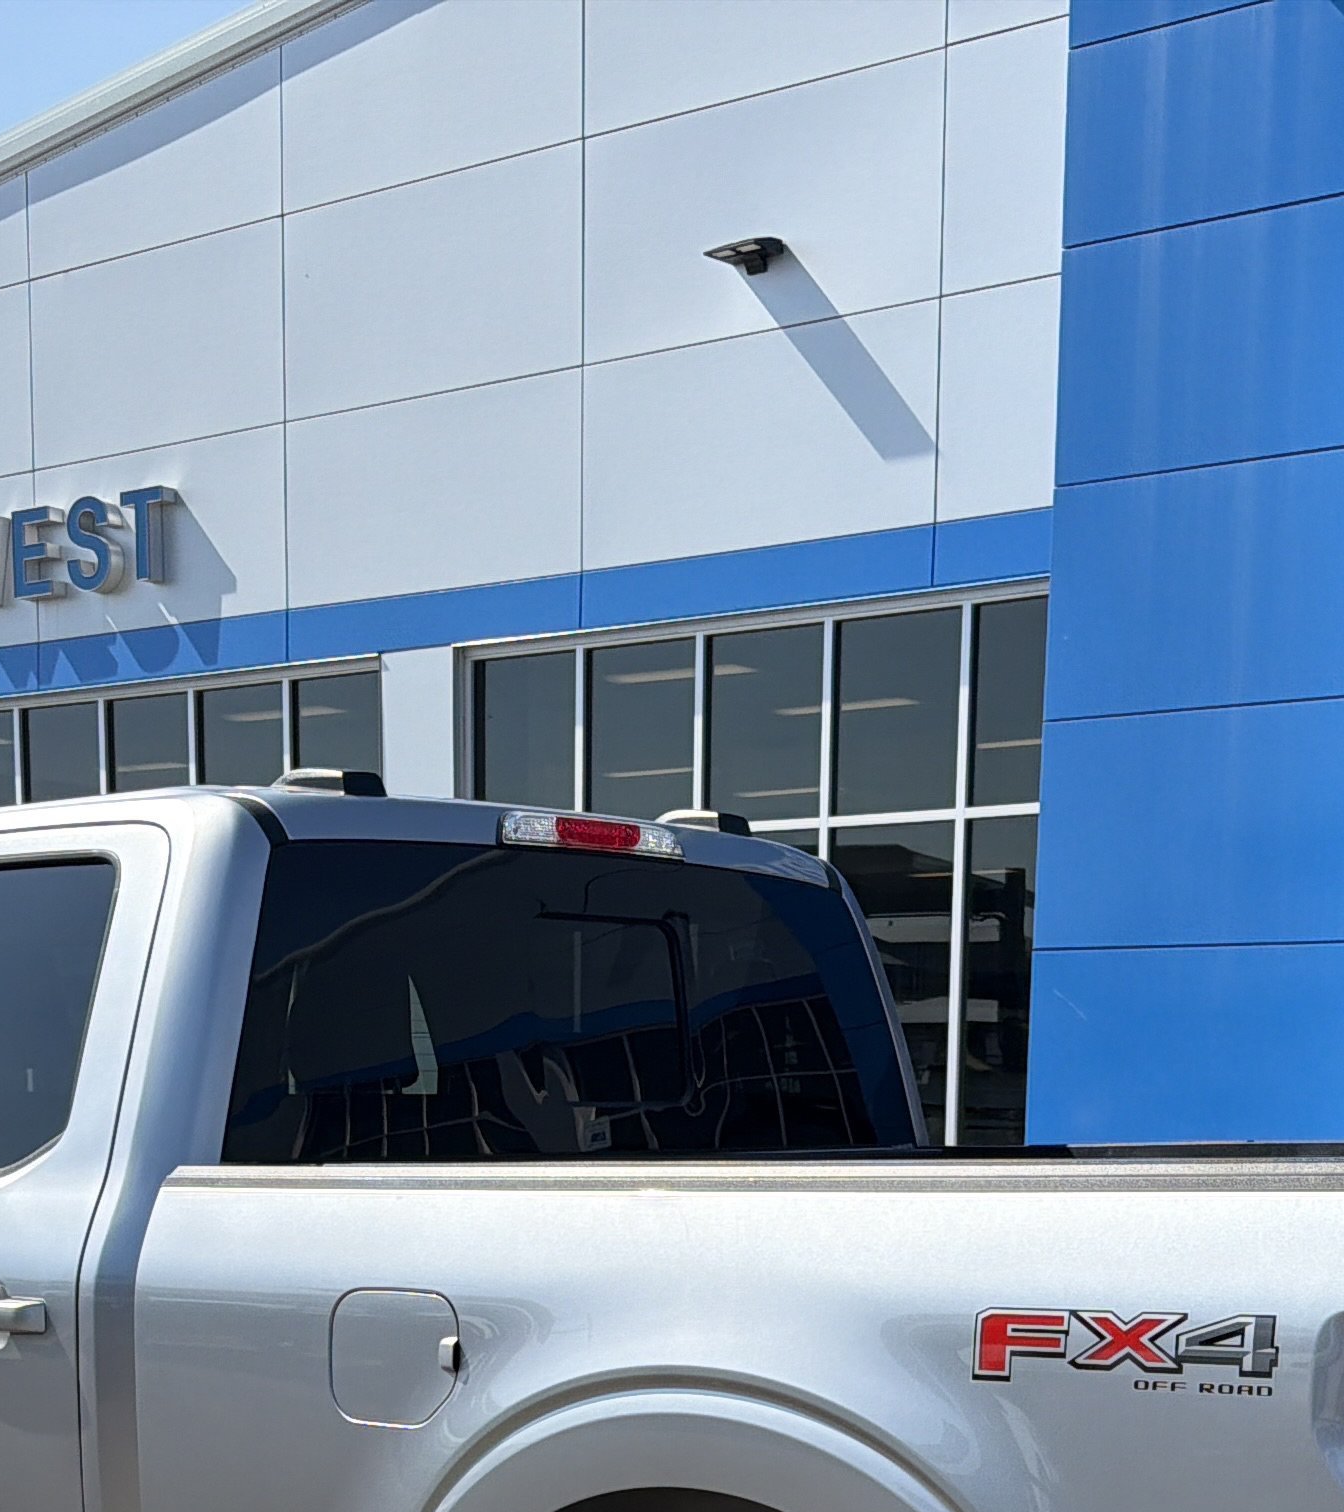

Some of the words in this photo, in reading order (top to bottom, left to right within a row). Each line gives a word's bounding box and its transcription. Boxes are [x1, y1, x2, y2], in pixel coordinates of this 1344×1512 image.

[971, 1307, 1279, 1382] FX4
[1133, 1379, 1187, 1392] OFF
[1198, 1382, 1274, 1397] ROAD
